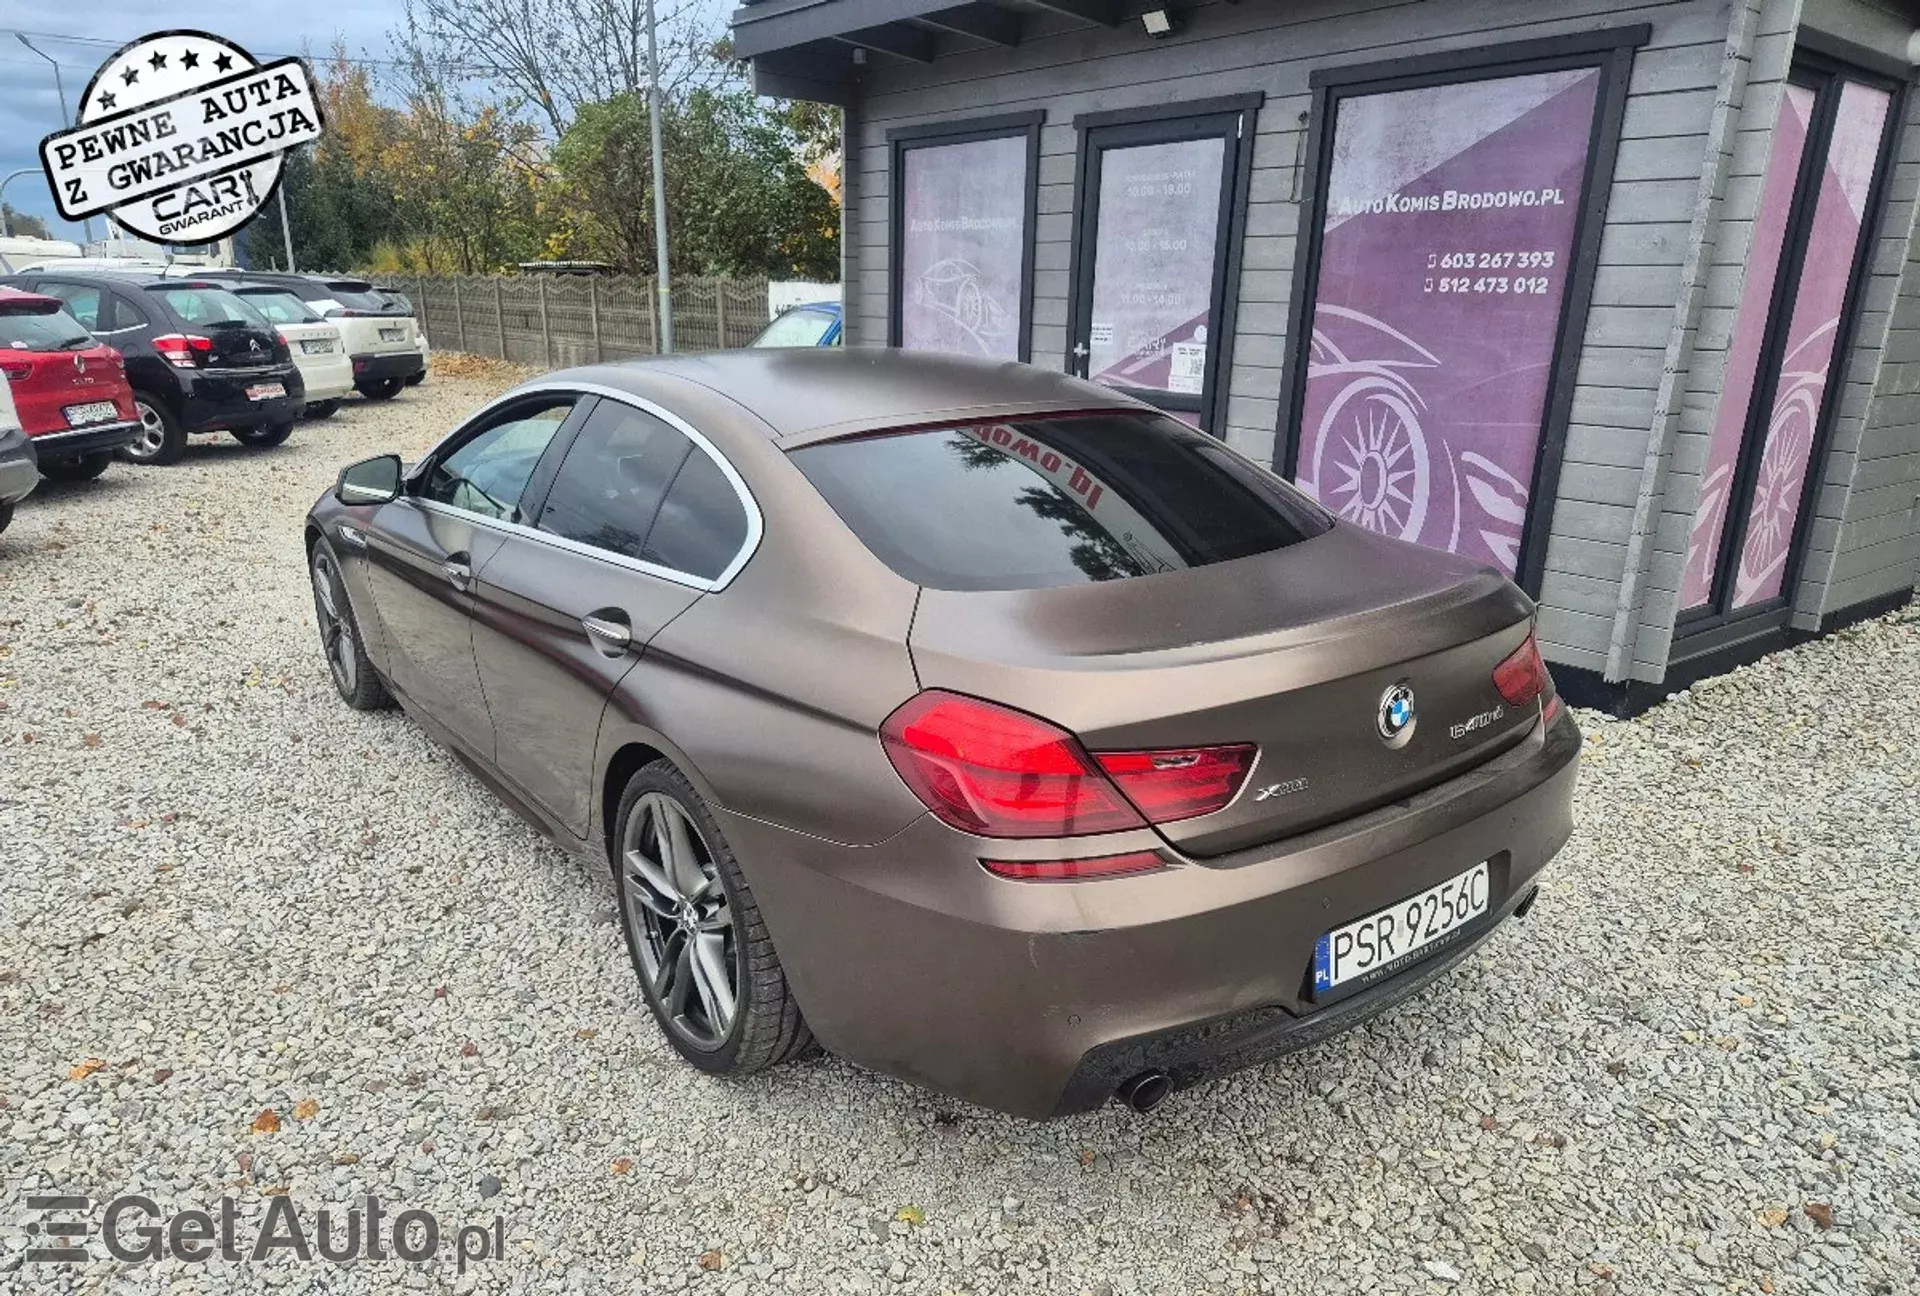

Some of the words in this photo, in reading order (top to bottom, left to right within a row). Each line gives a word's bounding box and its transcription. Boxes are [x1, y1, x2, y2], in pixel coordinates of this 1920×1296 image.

[1440, 252, 1476, 268] 603
[1479, 253, 1514, 268] 267
[1517, 251, 1555, 268] 393
[1438, 277, 1470, 293] 512
[1473, 277, 1509, 293] 473
[1513, 277, 1549, 294] 012
[1334, 914, 1395, 980] PSR
[1406, 868, 1484, 947] 9256C
[1315, 971, 1329, 984] PL
